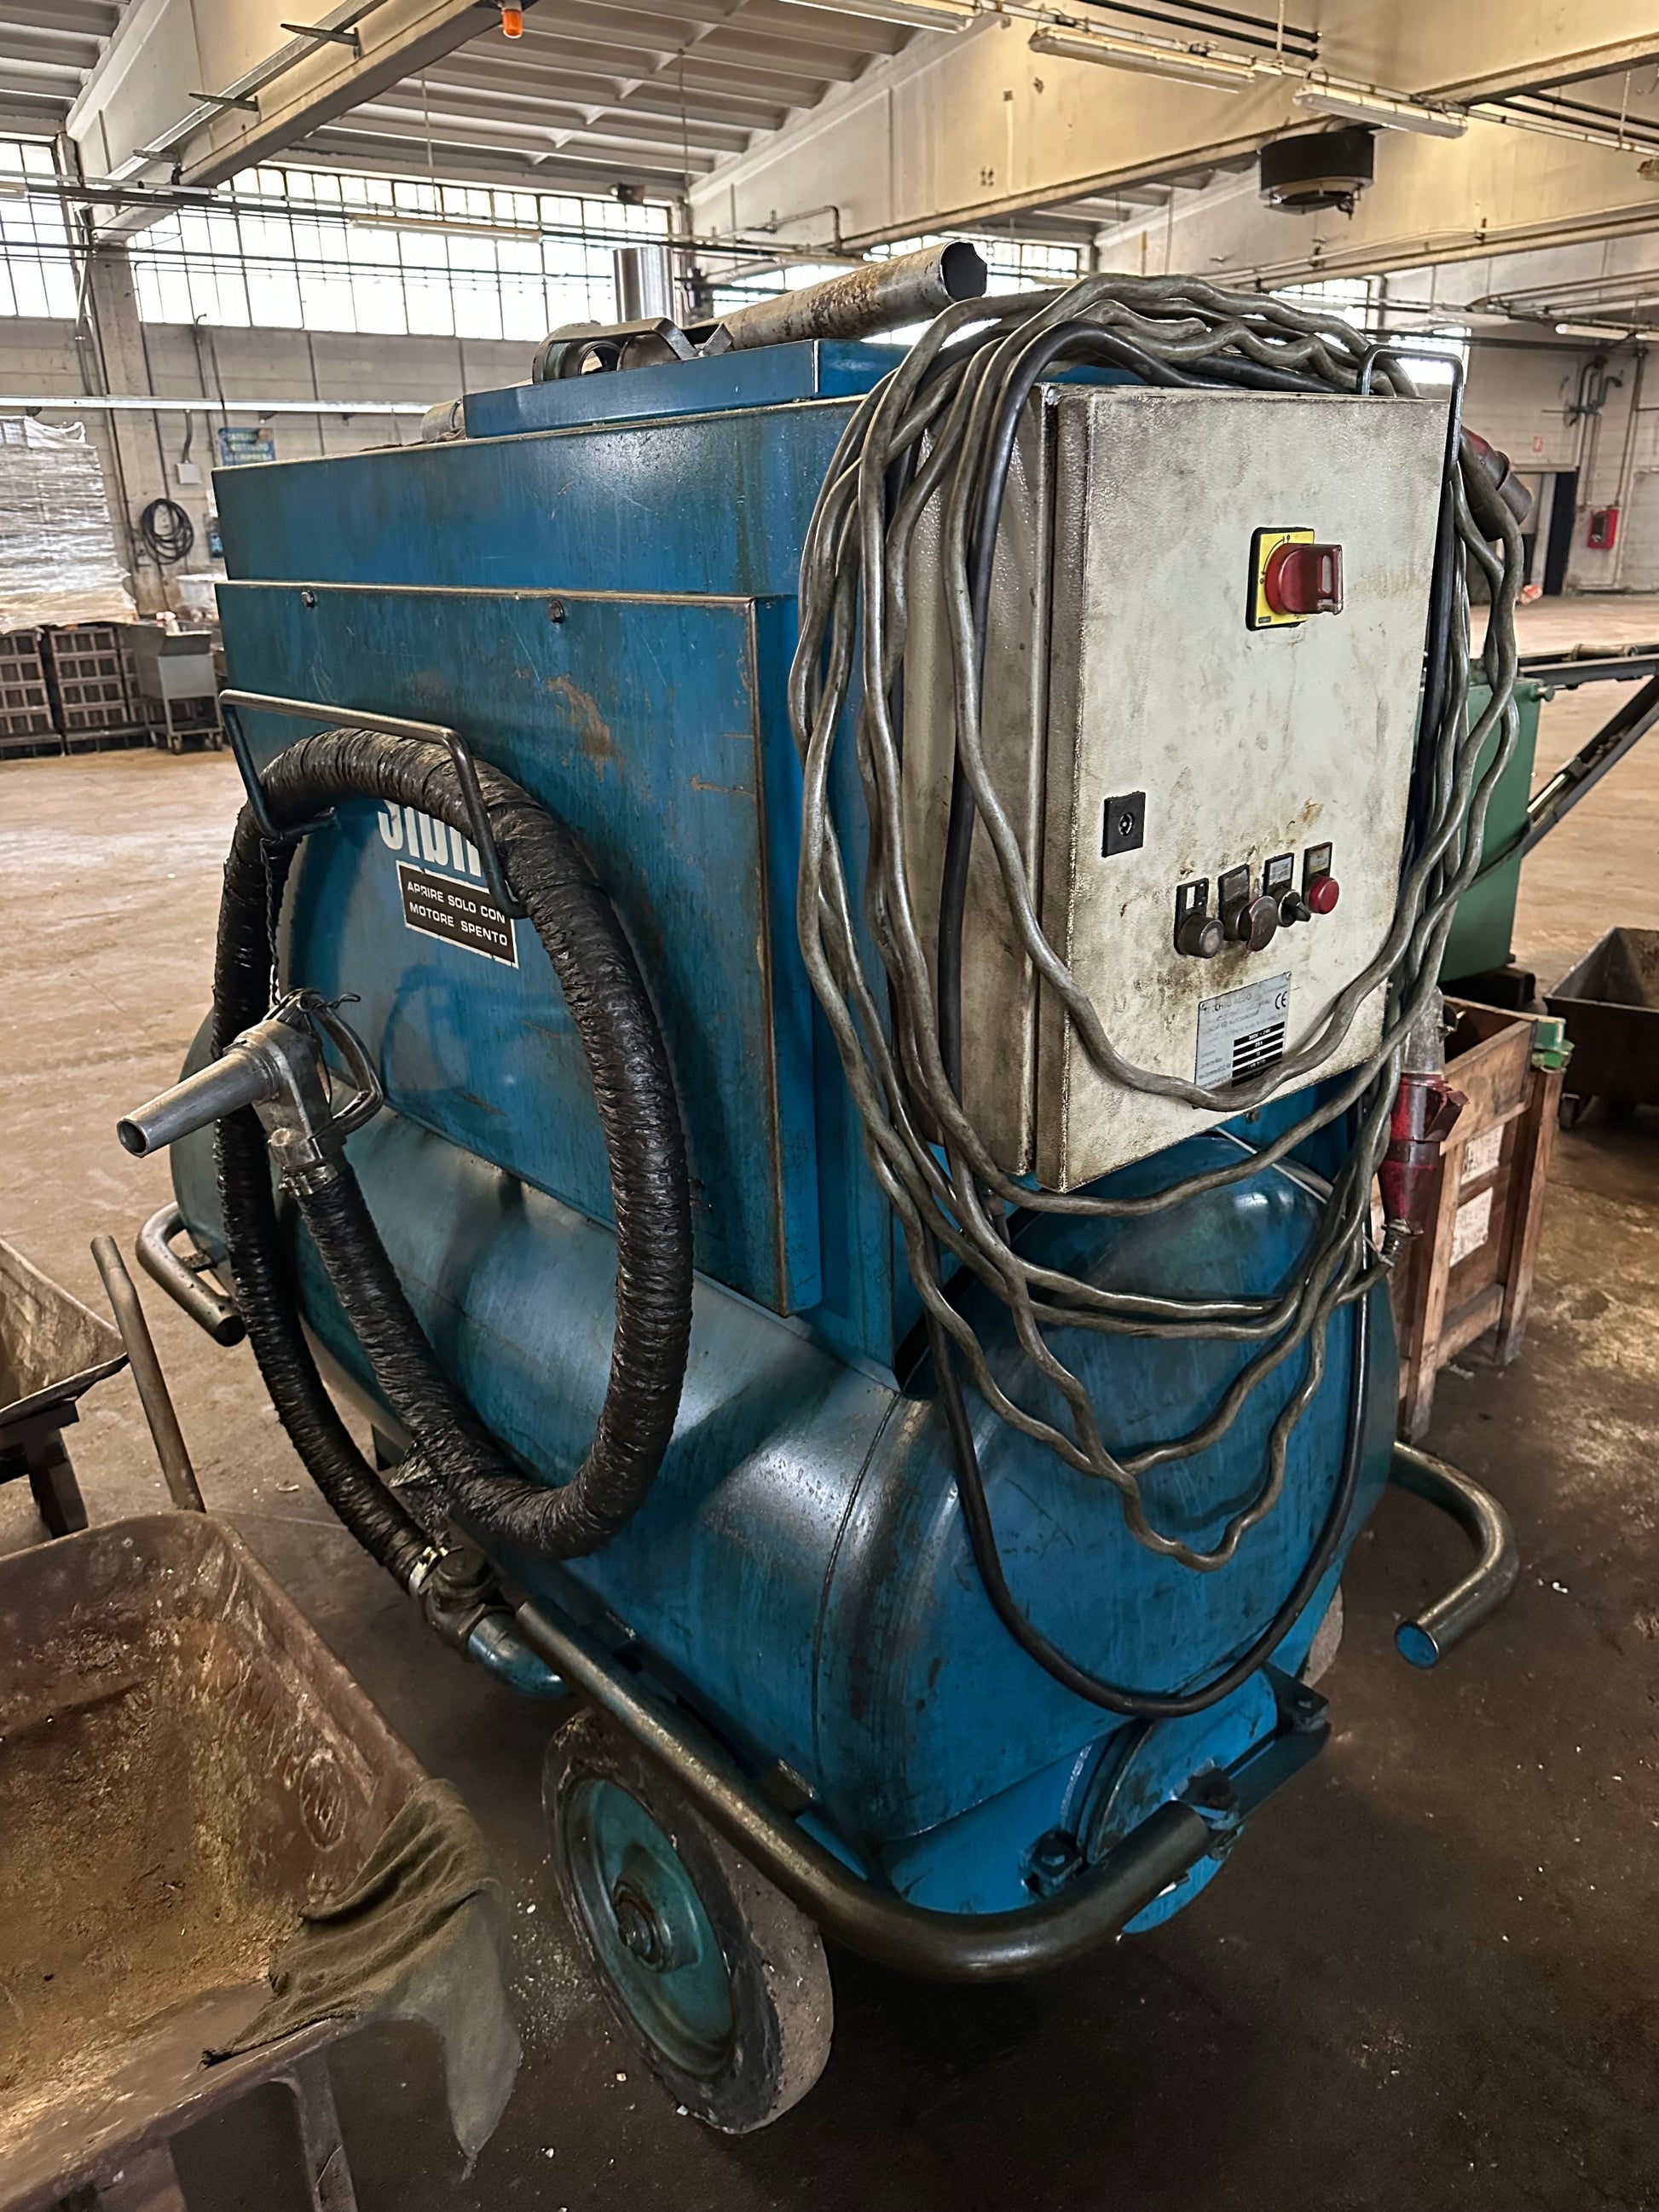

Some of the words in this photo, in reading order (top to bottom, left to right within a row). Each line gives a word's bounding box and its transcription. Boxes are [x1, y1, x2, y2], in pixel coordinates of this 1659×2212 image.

[408, 881, 444, 904] APRIRE
[447, 895, 477, 914] SOLO
[480, 907, 506, 924] CON
[409, 902, 454, 927] MOTORE
[460, 921, 508, 946] SPENTO
[1275, 990, 1287, 1010] CE
